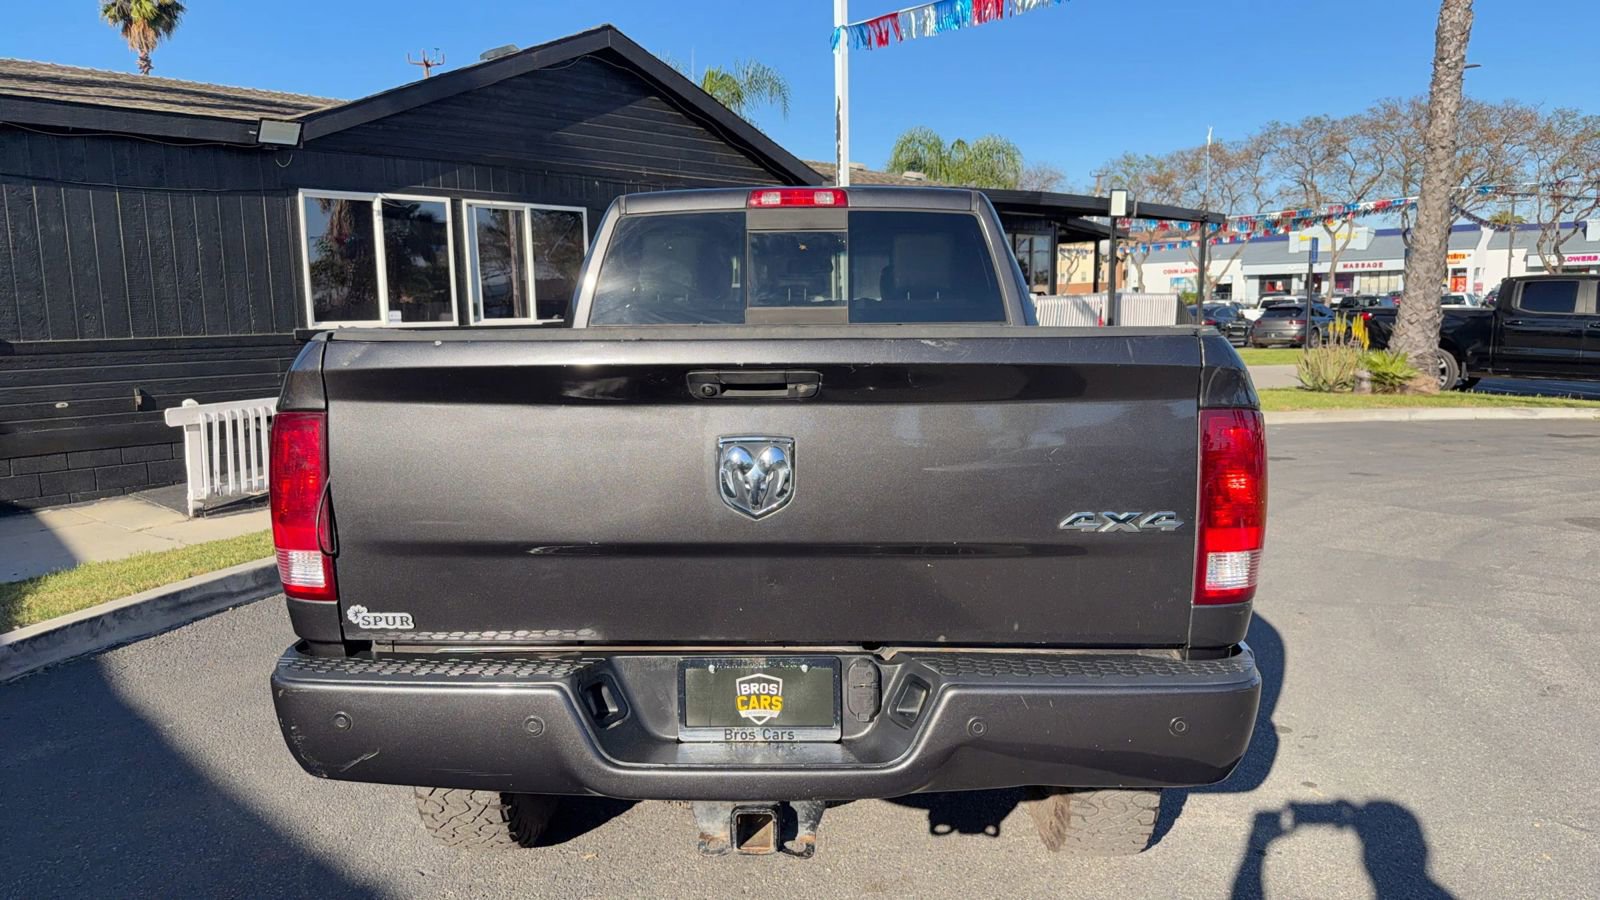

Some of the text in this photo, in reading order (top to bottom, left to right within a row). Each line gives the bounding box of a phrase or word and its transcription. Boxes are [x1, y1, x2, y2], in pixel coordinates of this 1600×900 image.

[1343, 261, 1384, 269] MASSAGE
[1058, 511, 1185, 533] 4X4
[361, 615, 411, 626] SPUR
[740, 683, 778, 695] BROS
[736, 695, 783, 711] CARS
[724, 728, 795, 741] Bros Cars
